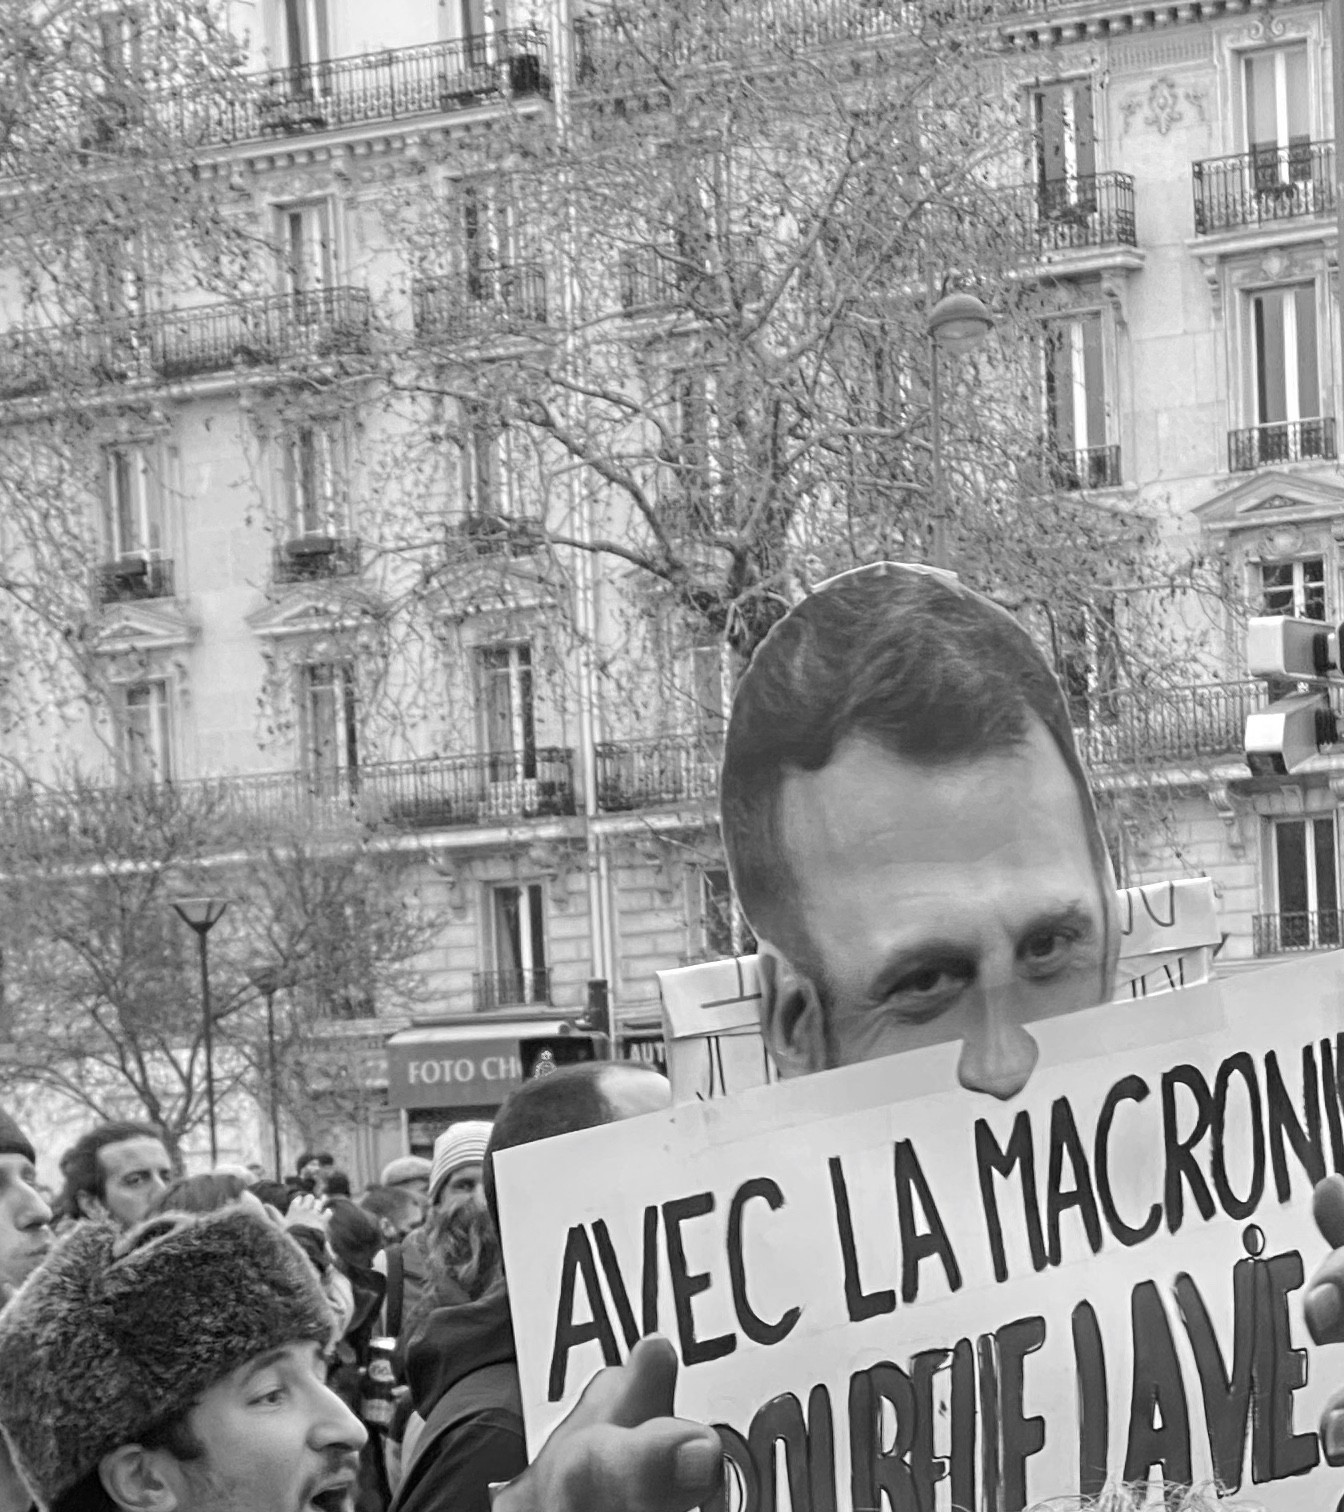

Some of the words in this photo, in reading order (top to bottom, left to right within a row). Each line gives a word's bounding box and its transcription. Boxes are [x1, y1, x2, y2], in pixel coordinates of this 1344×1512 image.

[408, 1058, 475, 1084] FOTO
[481, 1055, 523, 1080] CH
[547, 1176, 803, 1403] AVEC
[829, 1139, 962, 1323] LA
